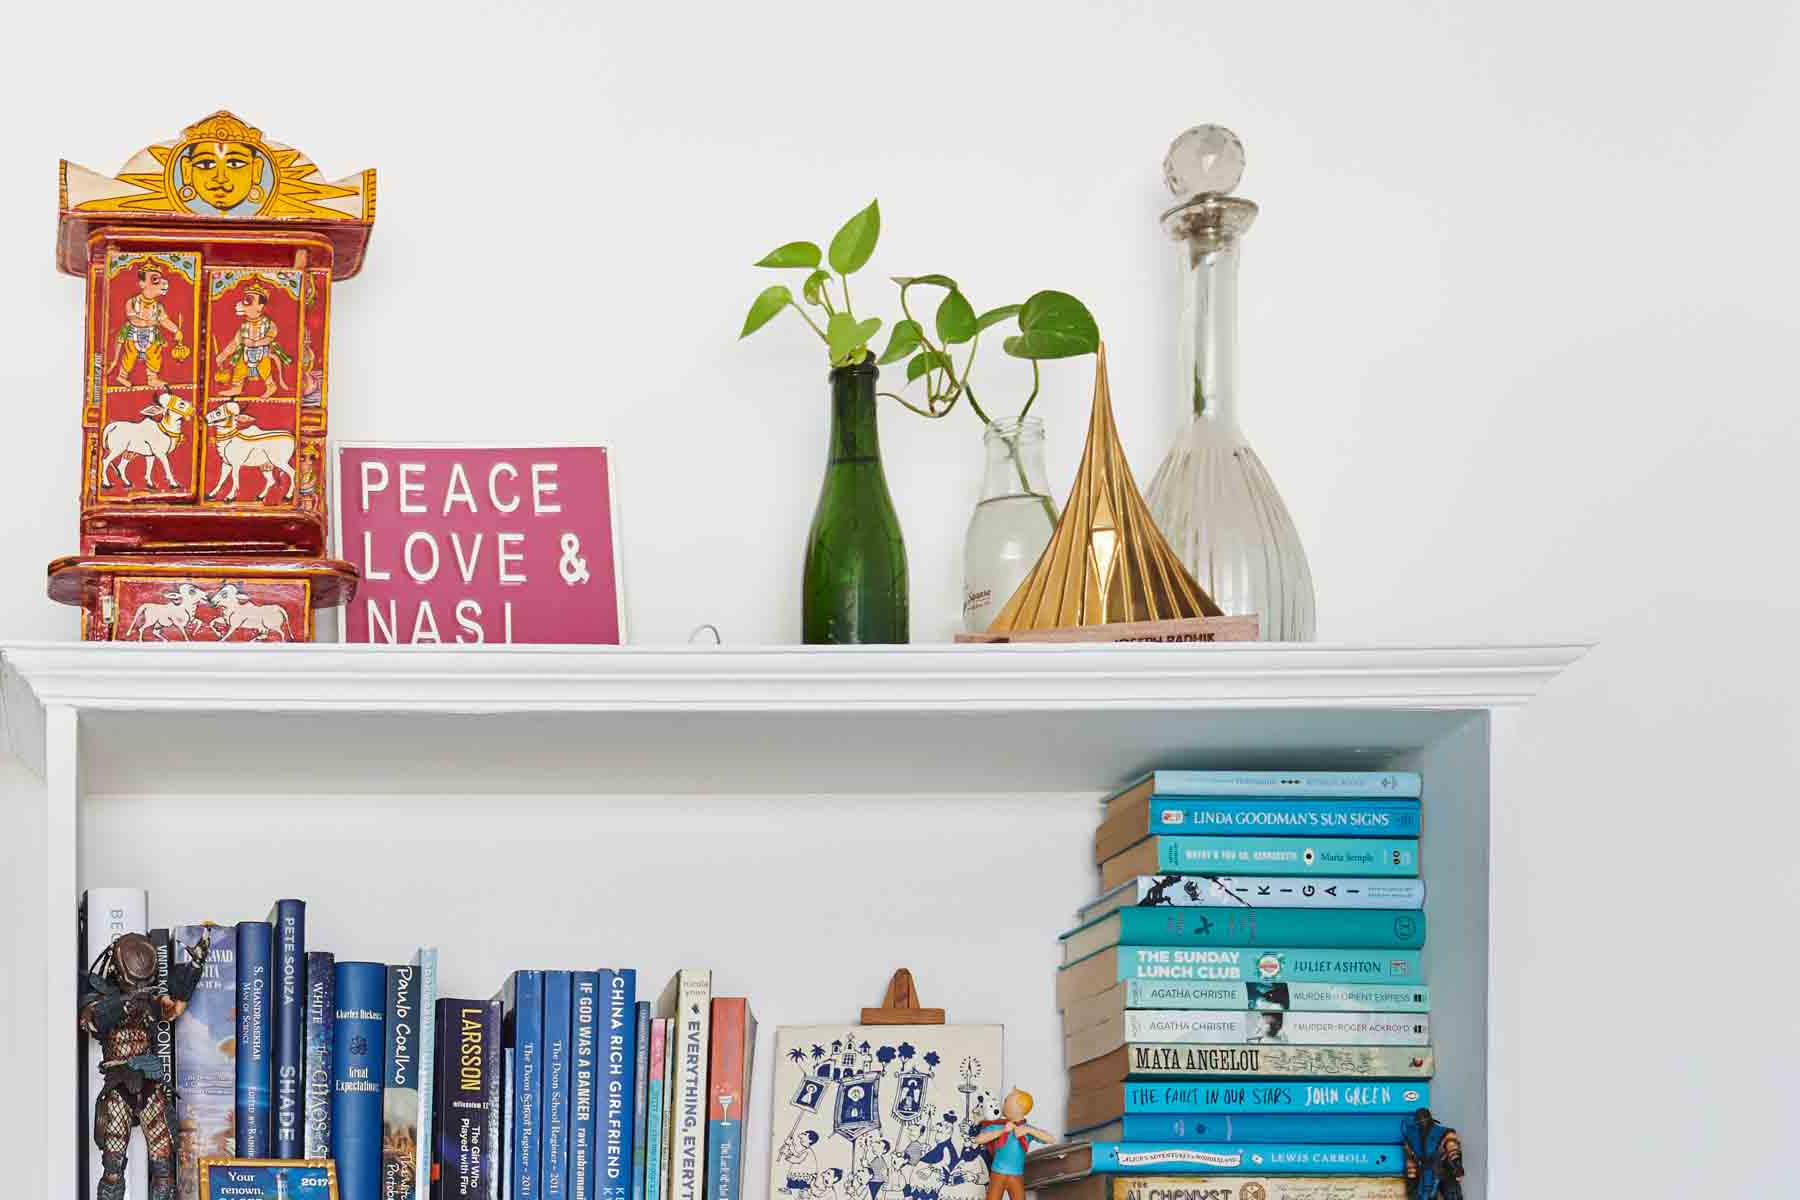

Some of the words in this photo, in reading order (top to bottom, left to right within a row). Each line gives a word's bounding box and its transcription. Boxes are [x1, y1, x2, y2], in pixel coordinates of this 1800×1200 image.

[361, 462, 561, 515] PEACE
[364, 531, 527, 584] LOVE
[559, 534, 590, 584] &
[1193, 810, 1233, 825] LINDA
[1235, 810, 1319, 826] GOODMAN'S
[1320, 812, 1347, 826] SUN
[1350, 812, 1389, 826] SIGNS
[1236, 884, 1361, 897] IKIGAI
[284, 917, 296, 945] PETE
[1136, 951, 1171, 963] THE
[1173, 951, 1240, 964] SUNDAY
[1293, 960, 1332, 973] JULIET
[1334, 960, 1382, 973] ASHTON
[283, 953, 296, 1006] SOUZA
[1137, 966, 1195, 978] LUNCH
[1198, 967, 1240, 978] CLUB
[396, 966, 413, 1018] Paulo
[610, 976, 625, 1029] CHINA
[1151, 988, 1191, 999] AGATHA
[1193, 988, 1238, 999] CHRISTIE
[395, 1024, 411, 1085] Coelho
[460, 1008, 482, 1091] LARSSON
[609, 1035, 624, 1075] RICH
[1135, 1048, 1183, 1071] MAYA
[1185, 1048, 1260, 1071] ANGELOU
[683, 1022, 700, 1133] EVERYTHING,
[279, 1066, 296, 1141] SHADE
[1132, 1088, 1158, 1104] THE
[1164, 1087, 1200, 1104] FAULT
[1205, 1088, 1220, 1104] IN
[1222, 1088, 1247, 1104] OUR
[1252, 1088, 1293, 1105] STARS
[1304, 1086, 1340, 1107] JOHN
[1344, 1086, 1392, 1105] GREEN
[607, 1080, 622, 1179] GIRLFRIEND
[1271, 1153, 1309, 1163] LEWIS
[1312, 1153, 1369, 1163] CARROLL
[228, 1171, 256, 1182] Your
[301, 1178, 328, 1187] 2017
